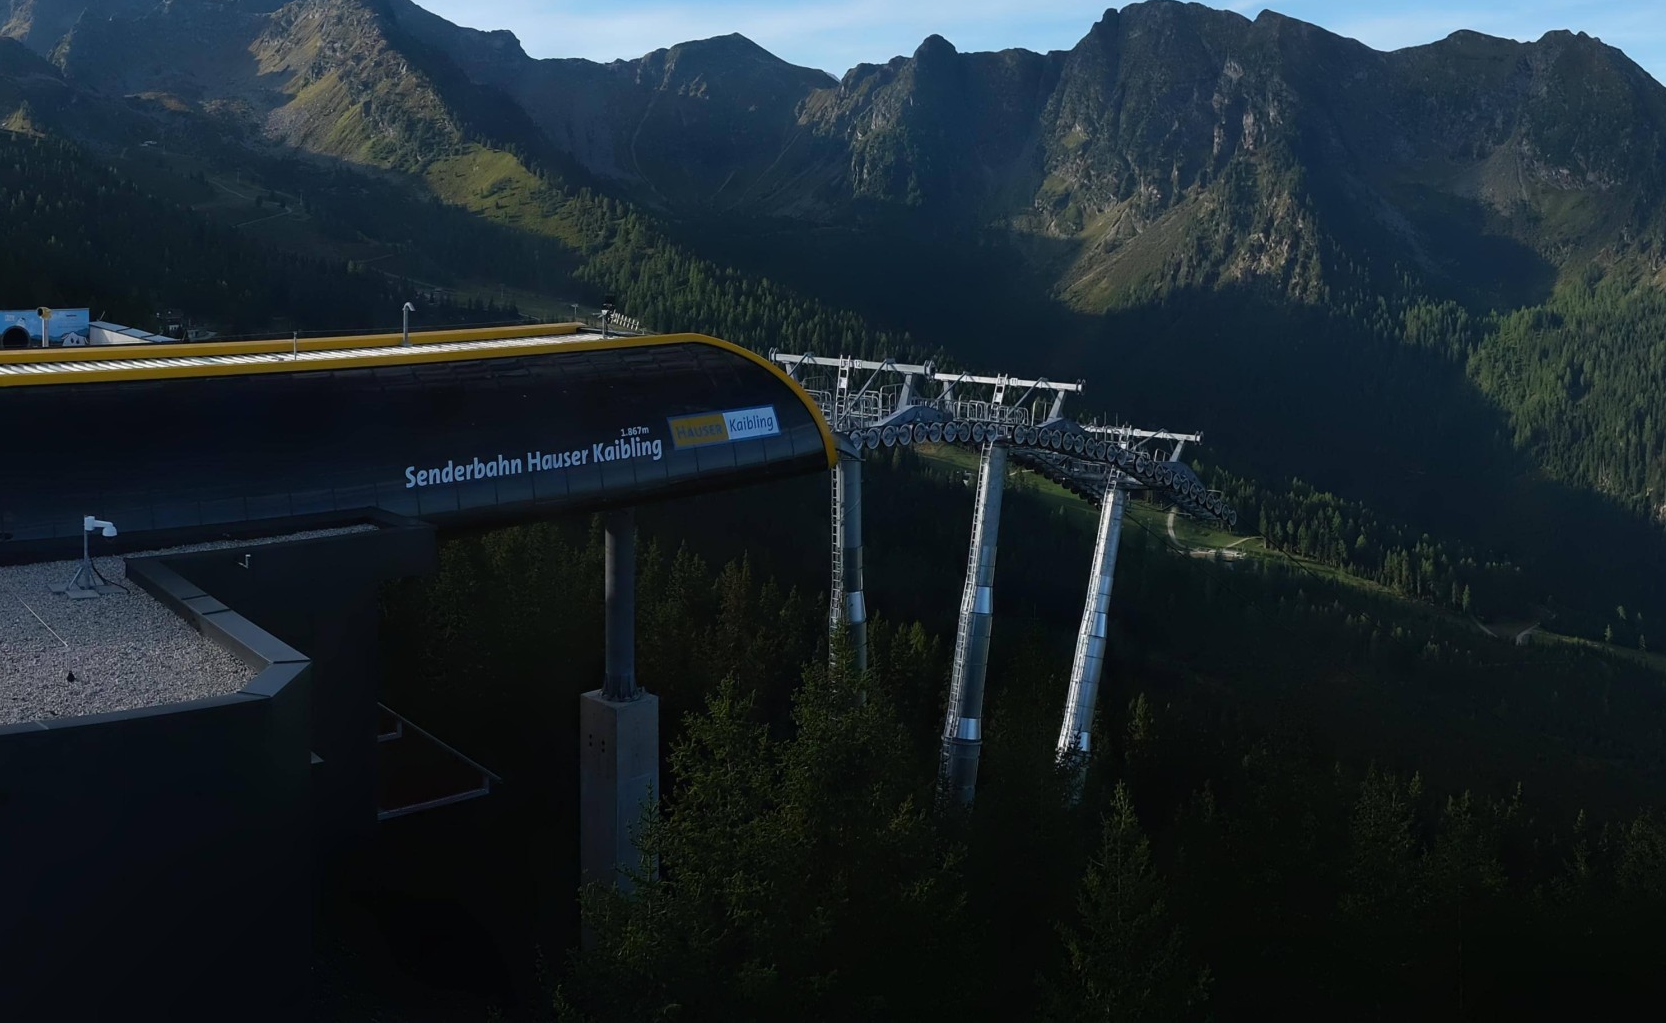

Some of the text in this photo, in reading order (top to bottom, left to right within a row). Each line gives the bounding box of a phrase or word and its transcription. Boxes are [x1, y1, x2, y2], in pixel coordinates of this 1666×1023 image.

[676, 414, 774, 439] HAUSER Kaibling
[405, 437, 662, 488] Senderbahn Hauser Kaibling
